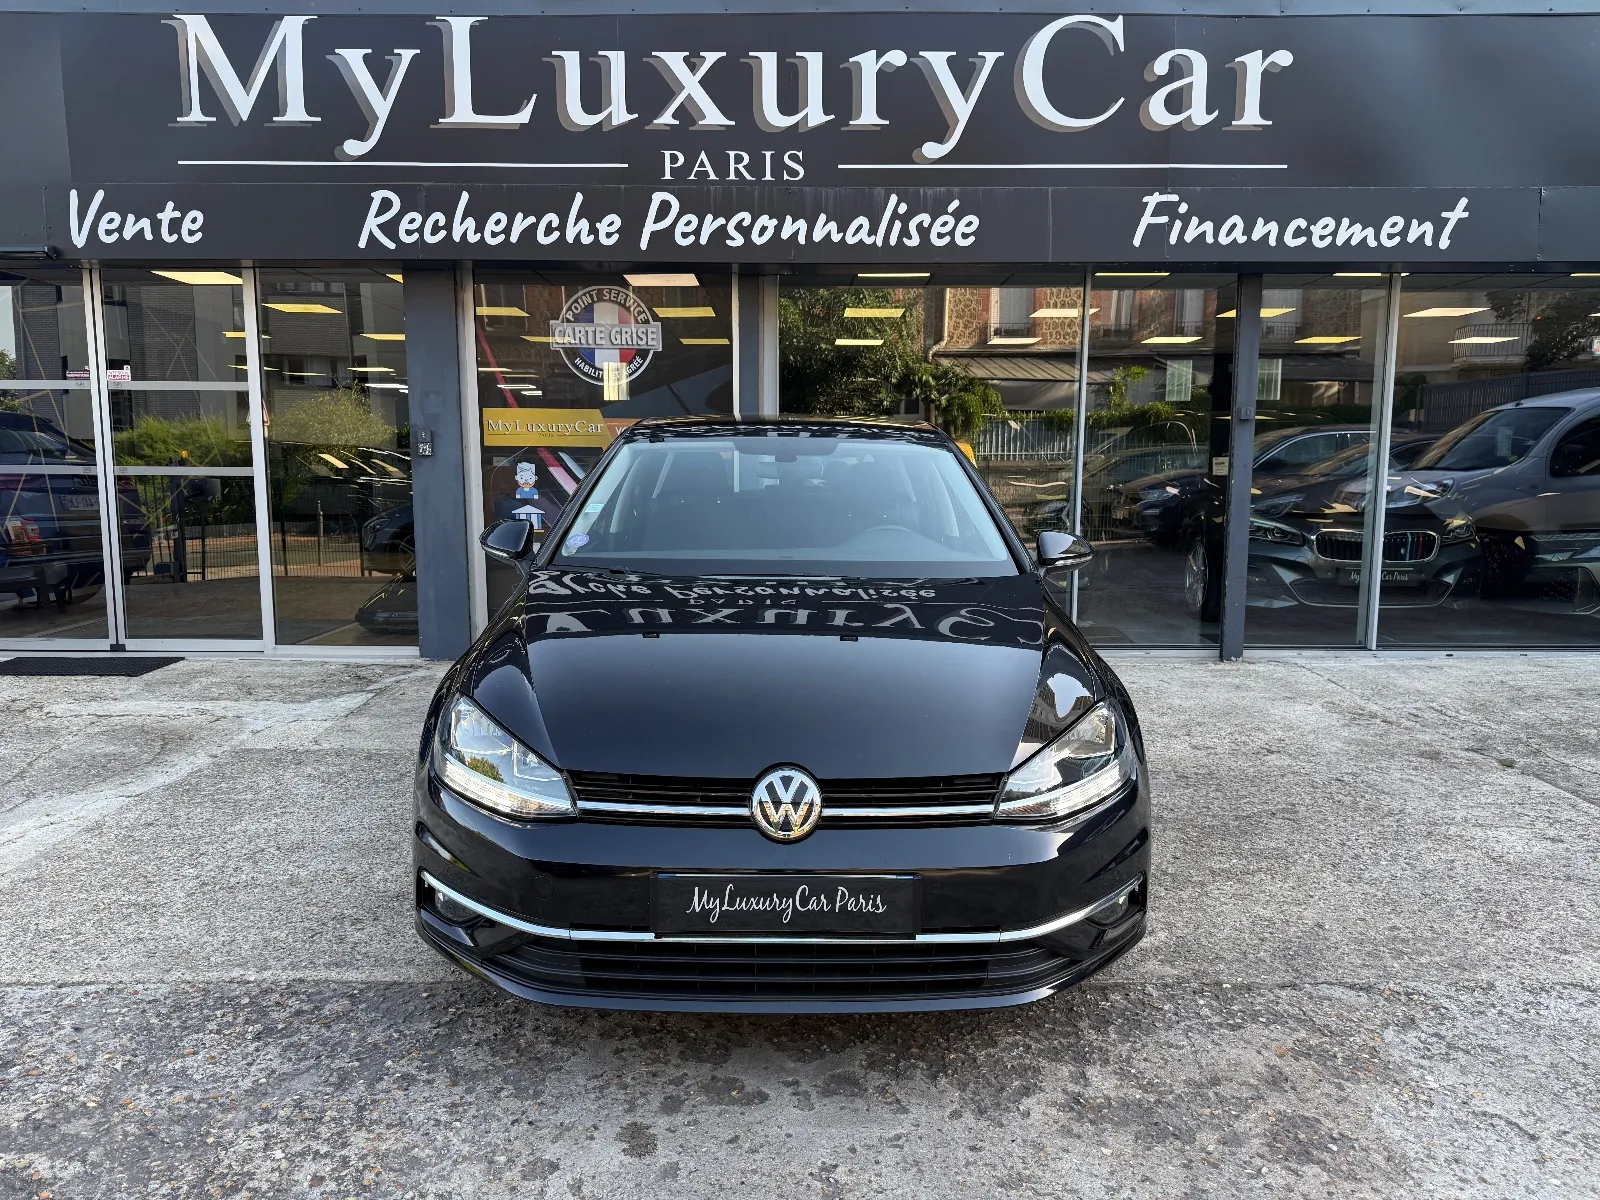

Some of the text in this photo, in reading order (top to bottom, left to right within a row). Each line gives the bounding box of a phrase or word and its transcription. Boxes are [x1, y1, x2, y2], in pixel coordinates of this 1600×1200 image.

[165, 14, 1294, 160] MyLuxuryCar
[661, 150, 805, 181] PARIS
[69, 188, 205, 249] Vente
[358, 189, 980, 250] Recherche Personnalisée
[1132, 192, 1469, 250] Financement
[565, 288, 648, 324] POINT SERVICE
[554, 326, 657, 346] CARTE GRISE
[574, 357, 609, 379] HABILIT
[486, 418, 605, 436] MyLuxuryCar
[686, 884, 887, 924] MyLuxuryCar Paris
